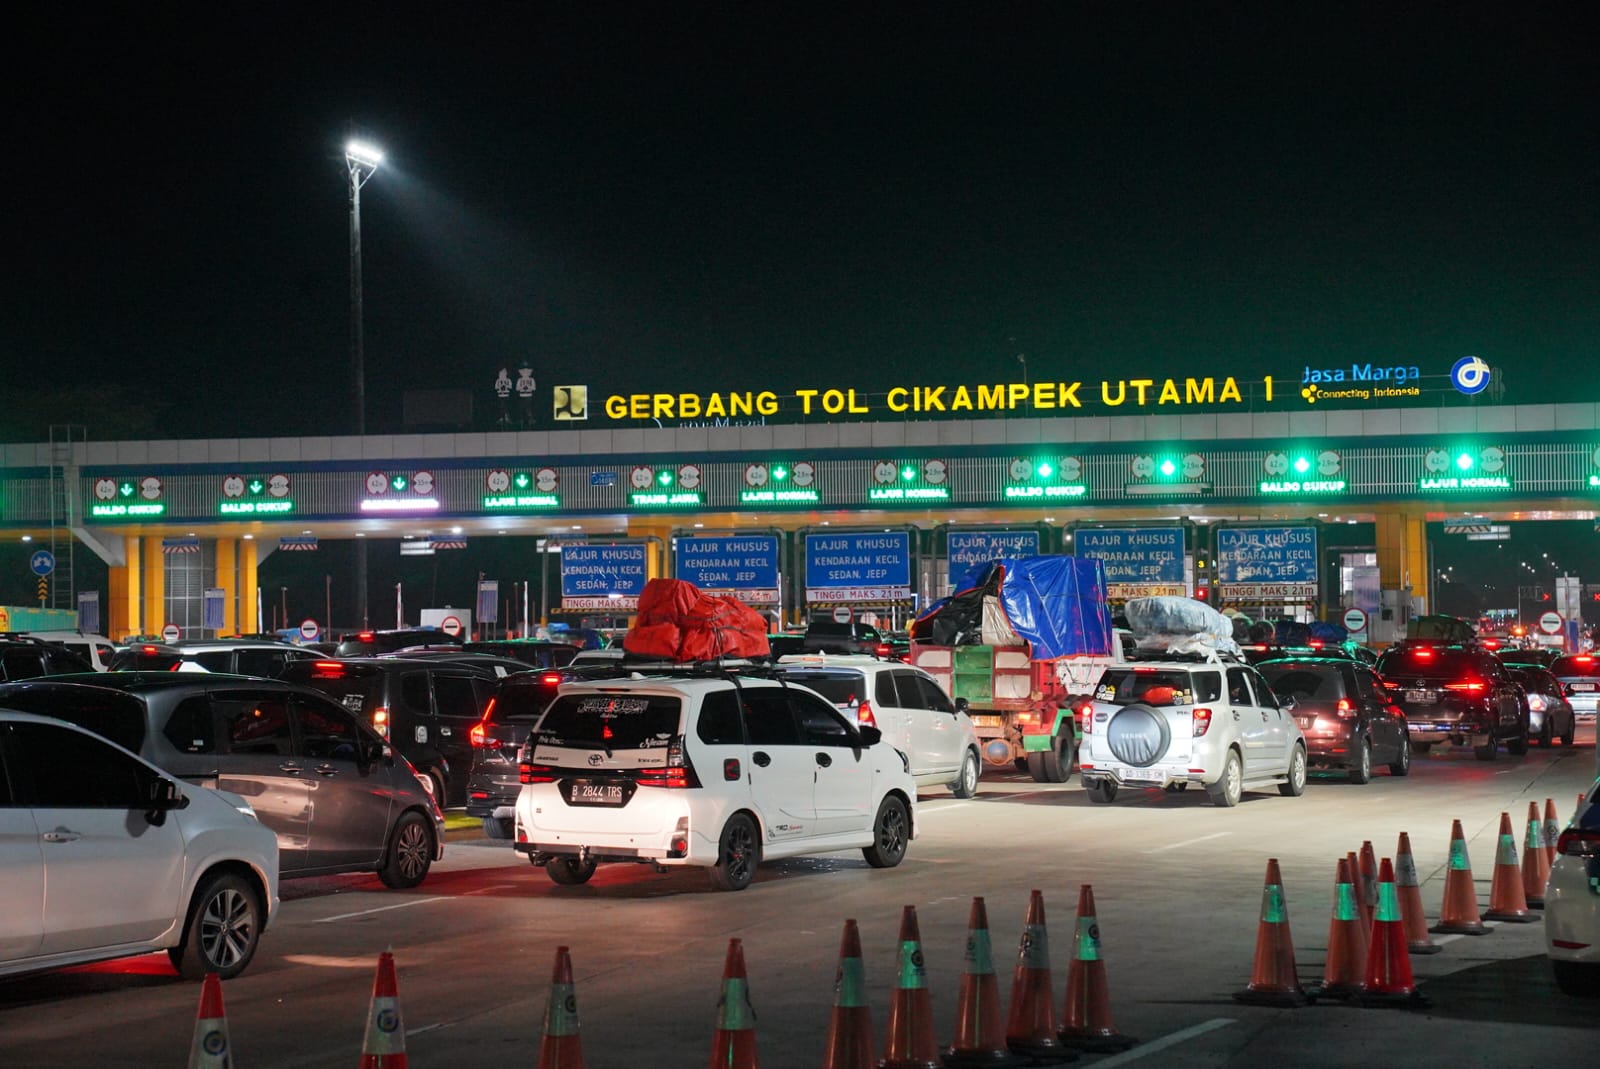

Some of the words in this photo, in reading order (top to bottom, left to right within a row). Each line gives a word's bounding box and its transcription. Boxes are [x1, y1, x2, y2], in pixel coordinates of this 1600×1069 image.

[1302, 366, 1345, 384] Jasa
[1352, 363, 1420, 385] Marga
[605, 390, 779, 419] GERBANG
[796, 387, 870, 415] TOL
[887, 381, 1083, 412] CIKAMPEK
[1101, 376, 1242, 408] UTAMA
[1263, 375, 1273, 401] 1
[1316, 389, 1370, 399] Connecting
[1374, 387, 1420, 397] Indonesia
[1260, 482, 1300, 492] SALDO
[1302, 481, 1346, 491] CUKUP
[1420, 478, 1458, 488] LAJUR
[1461, 478, 1510, 488] NORMAL
[742, 492, 774, 501] LAJUR
[776, 491, 818, 500] NORMAL
[870, 489, 904, 498] LAJUR
[905, 488, 948, 498] NORMAL
[484, 496, 516, 508] LAJUR
[518, 496, 558, 506] NORMAL
[632, 494, 668, 504] TRANS
[669, 494, 700, 503] JAWA
[952, 537, 986, 548] LAJUR
[991, 536, 1034, 547] KHUSUS
[1084, 535, 1121, 546] LAJUR
[1128, 534, 1176, 544] KHUSUS
[1222, 534, 1259, 544] LAJUR
[1264, 533, 1312, 544] KHUSUS
[684, 543, 718, 552] LAJUR
[726, 542, 770, 552] KHUSUS
[815, 540, 848, 550] LAJUR
[856, 538, 900, 550] KHUSUS
[565, 550, 598, 560] LAJUR
[602, 550, 642, 560] KHUSUS
[1084, 551, 1144, 560] KENDARAAN
[1149, 551, 1176, 560] KECIL
[1220, 551, 1281, 560] KENDARAAN
[1286, 550, 1312, 560] KECIL
[684, 558, 740, 568] KENDARAAN
[744, 558, 768, 567] KECIL
[815, 556, 871, 566] KENDARAAN
[875, 555, 900, 564] KECIL
[564, 566, 618, 575] KENDARAAN
[620, 566, 642, 575] KECIL
[866, 569, 888, 578] JEEP
[1139, 566, 1162, 575] JEEP
[1276, 566, 1299, 575] JEEP
[736, 572, 756, 580] JEEP
[614, 581, 634, 590] JEEP
[814, 591, 845, 600] TINGGI
[1223, 587, 1256, 596] TINGGI
[566, 600, 594, 608] TINGGI
[572, 785, 578, 796] B
[582, 786, 604, 797] 2844
[607, 786, 622, 798] TRS
